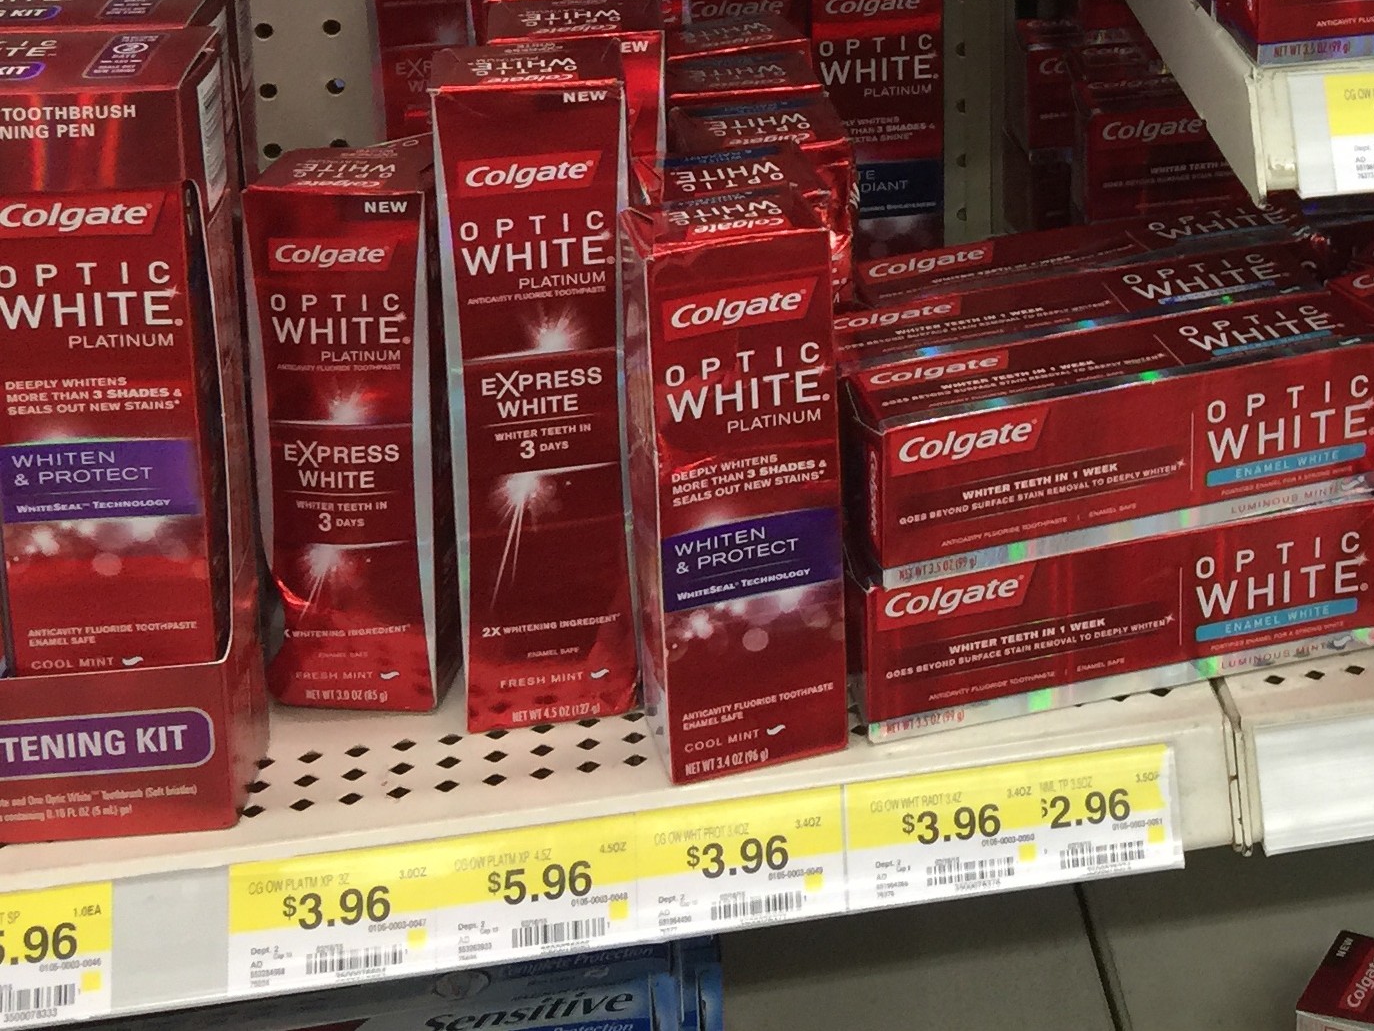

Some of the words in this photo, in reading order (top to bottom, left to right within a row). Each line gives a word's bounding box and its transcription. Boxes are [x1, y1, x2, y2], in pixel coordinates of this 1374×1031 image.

[818, 33, 933, 57] OPTIC
[819, 55, 933, 86] WHITE
[464, 160, 588, 191] Colgate
[0, 202, 148, 232] Colgate
[364, 200, 408, 213] NEW
[274, 244, 385, 268] Colgate
[0, 290, 173, 330] WHITE
[671, 291, 802, 329] Colgate
[68, 332, 174, 350] PLATINUM
[271, 316, 400, 345] WHITE
[481, 367, 603, 400] EXPRESS
[727, 409, 821, 434] PLATINUM
[1206, 403, 1369, 464] WHITE
[284, 440, 400, 469] EXPRESS
[897, 420, 1033, 464] Colgate
[671, 464, 717, 484] DEEPLY
[720, 454, 778, 472] WHITENS
[318, 513, 332, 532] 3
[336, 518, 365, 528] DAYS
[1224, 616, 1278, 634] ENAMEL
[1284, 602, 1330, 621] WHITE
[500, 676, 546, 689] FRESH
[551, 671, 583, 683] MINT
[136, 724, 187, 753] KIT
[684, 738, 723, 754] COOL
[727, 728, 760, 744] MINT
[902, 803, 1002, 846] $3.96
[686, 835, 790, 880] $3.96
[487, 860, 593, 905] $5.96
[282, 885, 392, 930] $3.96
[1336, 937, 1354, 959] NEW
